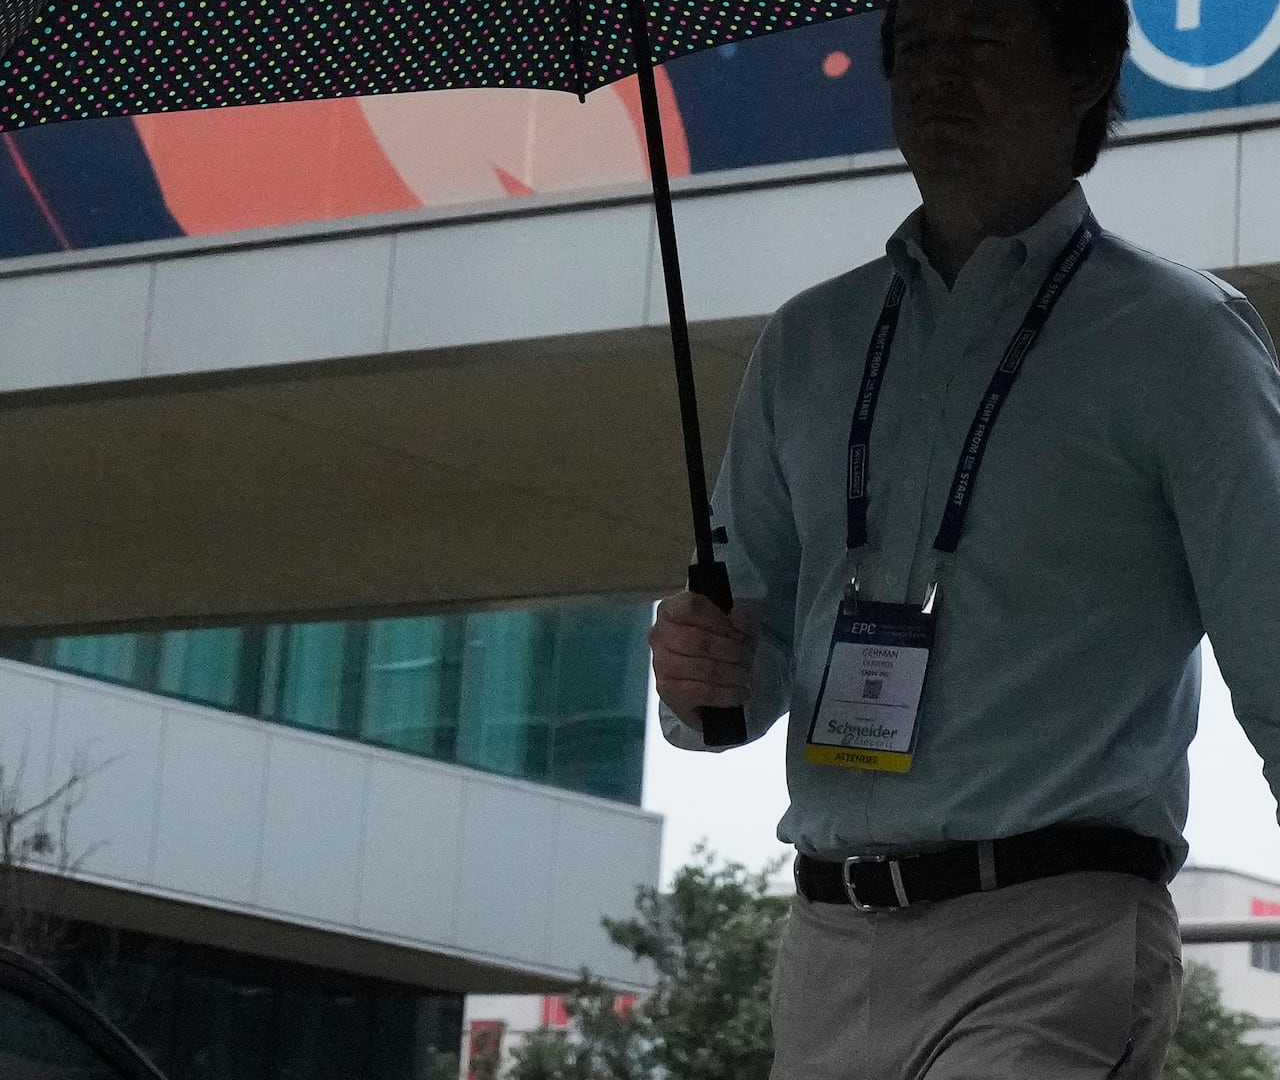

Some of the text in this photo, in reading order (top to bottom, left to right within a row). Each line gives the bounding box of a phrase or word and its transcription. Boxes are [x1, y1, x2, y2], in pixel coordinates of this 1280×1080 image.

[857, 392, 872, 421] START
[981, 393, 1000, 422] RIGHT
[968, 423, 986, 454] FROM
[953, 472, 970, 506] START
[851, 622, 876, 634] EPC
[827, 719, 897, 739] Schneider
